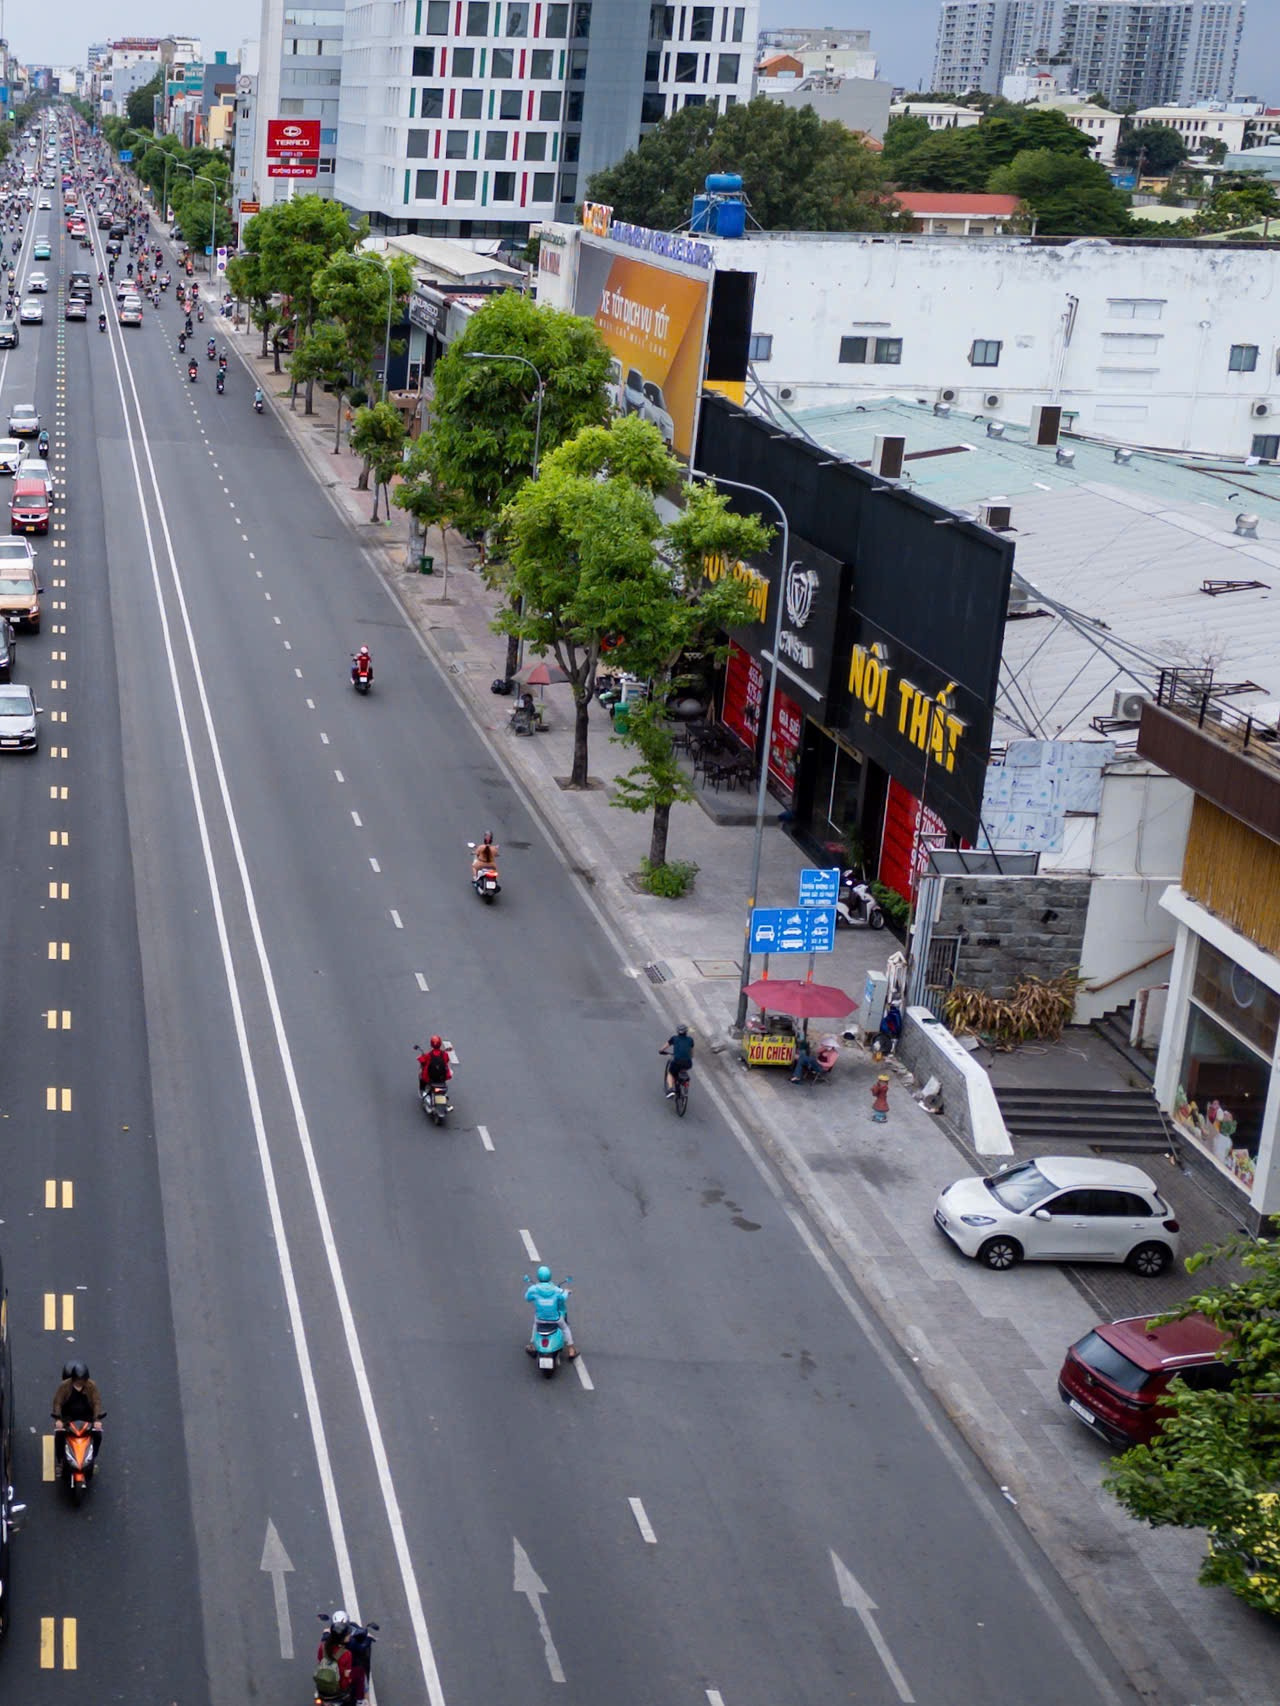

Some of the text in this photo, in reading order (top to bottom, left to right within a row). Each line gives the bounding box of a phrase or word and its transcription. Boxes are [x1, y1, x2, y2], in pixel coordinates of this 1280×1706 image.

[601, 286, 670, 340] XE TỐT DỊCH VỤ TỐT
[849, 642, 890, 724] NỘI
[899, 681, 965, 773] THẤT
[750, 1043, 764, 1060] XÔI
